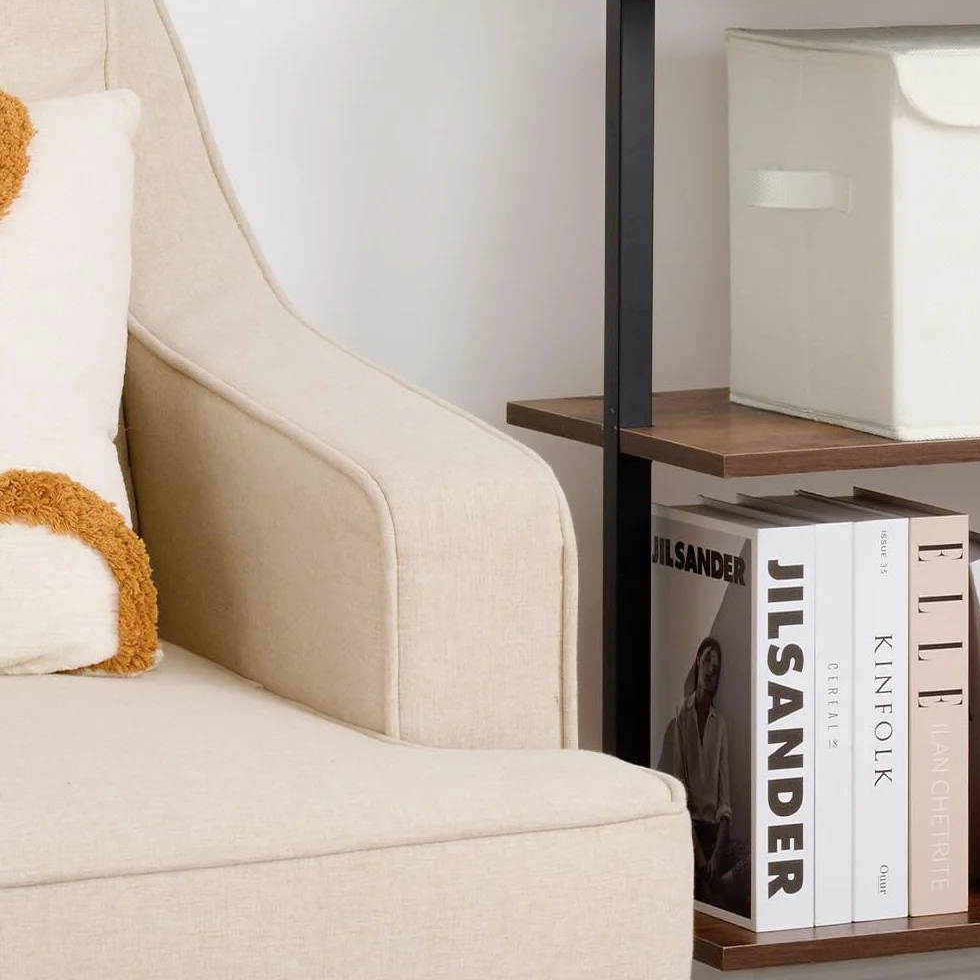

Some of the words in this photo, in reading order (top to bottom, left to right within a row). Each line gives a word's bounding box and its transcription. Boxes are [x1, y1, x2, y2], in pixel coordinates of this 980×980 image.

[880, 529, 888, 559] ISSUE
[880, 562, 888, 575] 35
[917, 543, 964, 708] ELLE
[827, 662, 839, 731] CEREAL
[874, 634, 894, 788] KINFOLK
[931, 722, 950, 772] ILAN
[931, 779, 950, 893] CHETRITE
